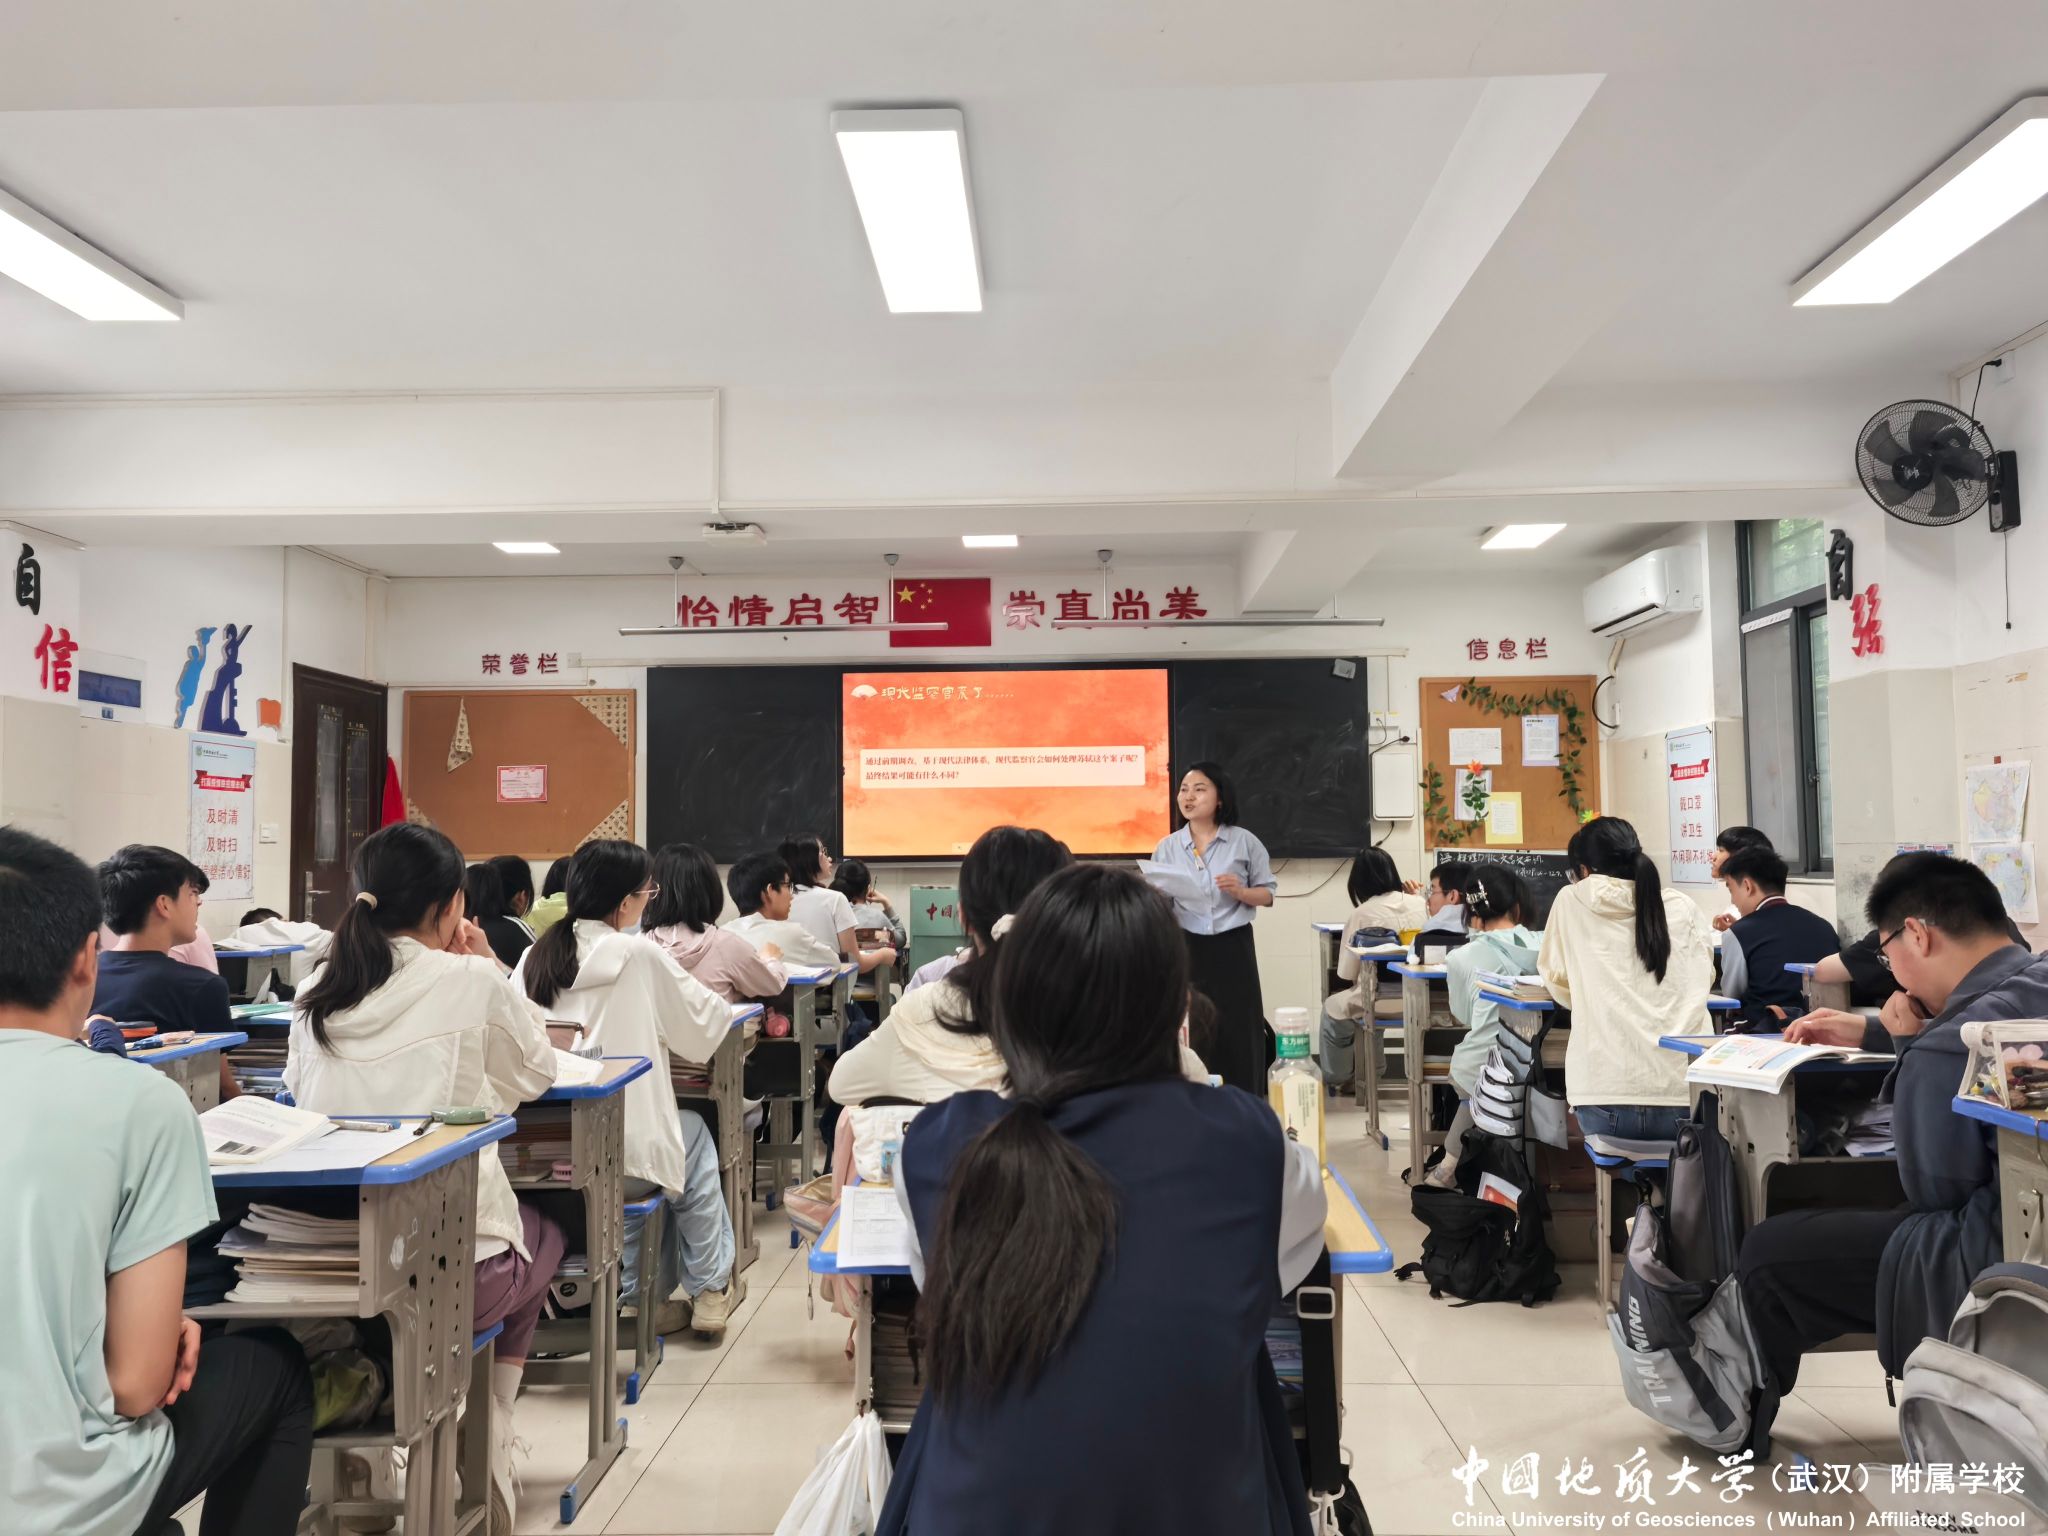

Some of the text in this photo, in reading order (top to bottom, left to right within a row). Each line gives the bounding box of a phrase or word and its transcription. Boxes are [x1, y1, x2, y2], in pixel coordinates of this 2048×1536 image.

[677, 586, 1208, 630] 怡情启智 崇真尚美
[1466, 638, 1548, 660] 信息栏
[481, 653, 559, 675] 荣誉栏
[207, 808, 238, 825] 及时清
[207, 837, 237, 853] 及时扫
[198, 864, 251, 880] 整洁心情好
